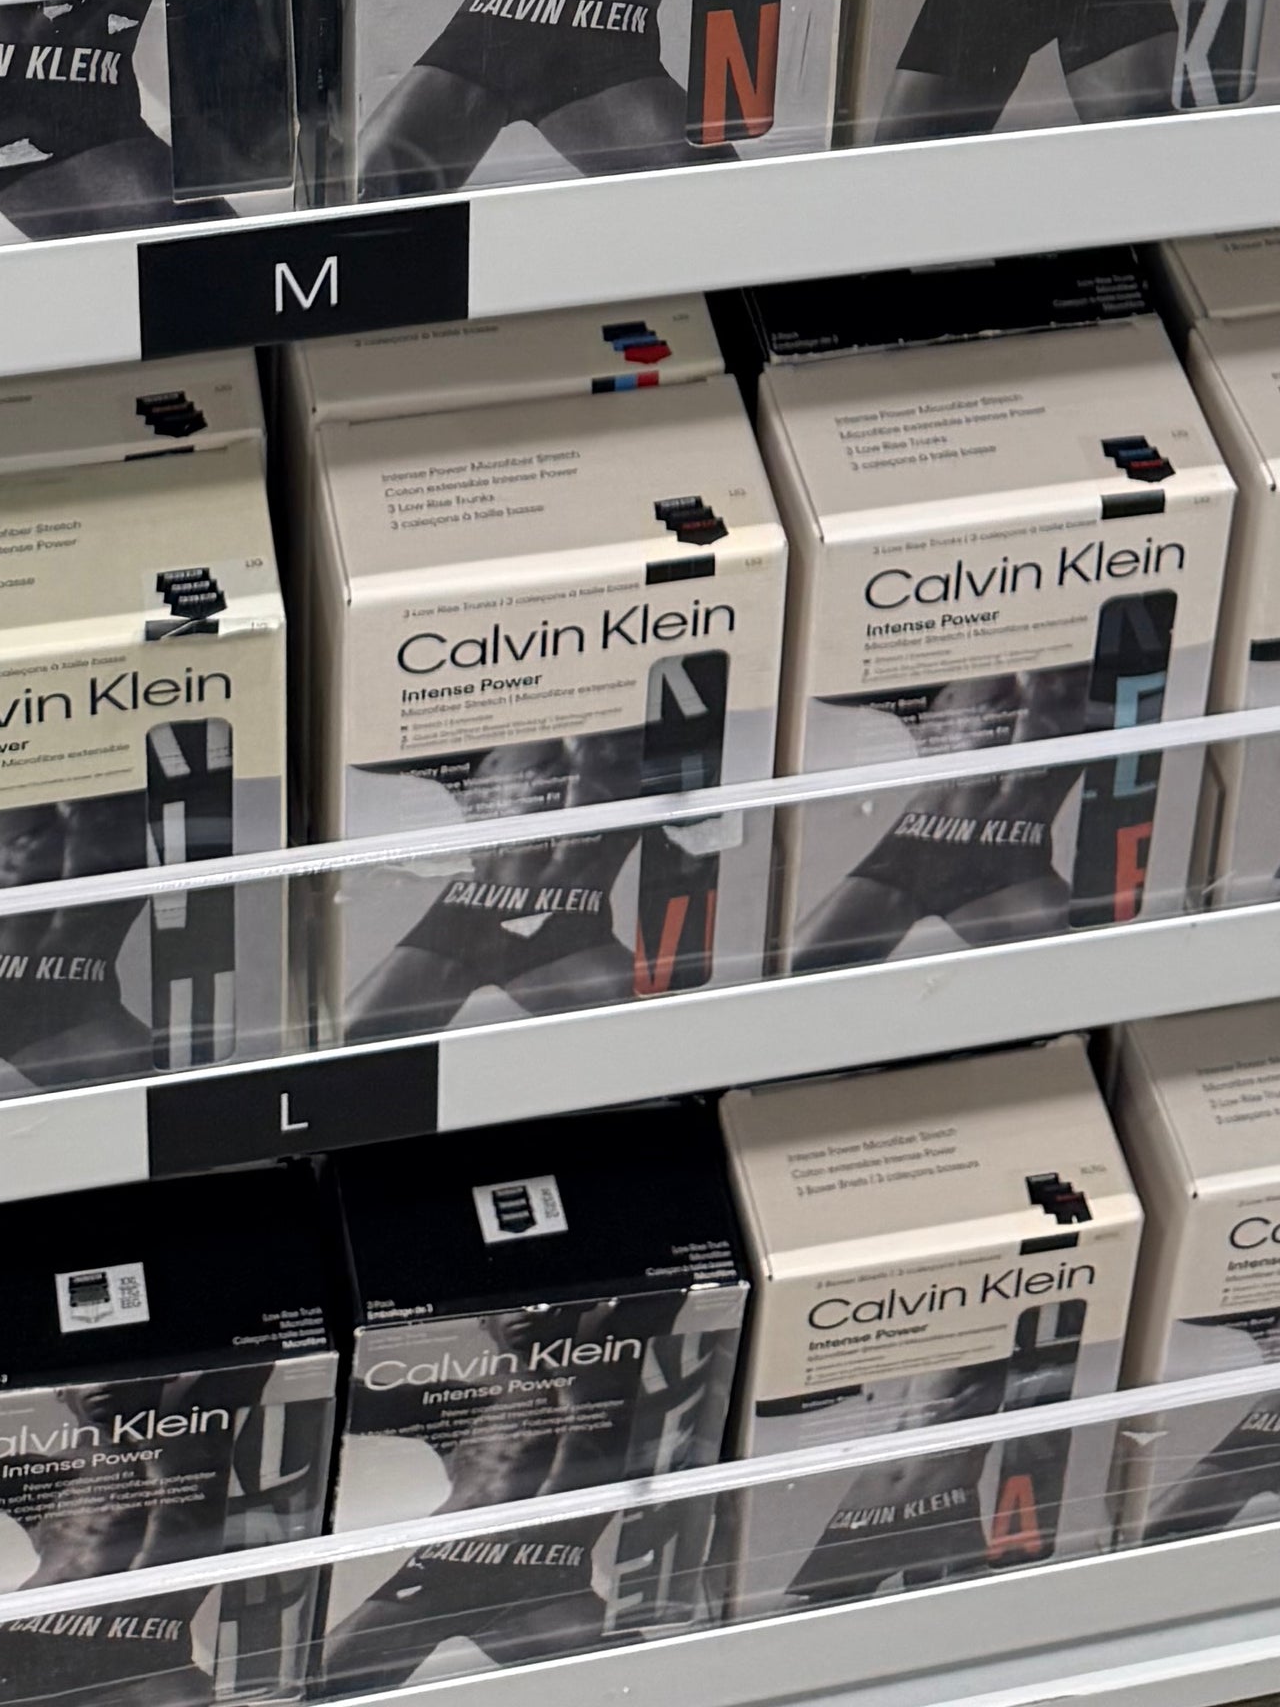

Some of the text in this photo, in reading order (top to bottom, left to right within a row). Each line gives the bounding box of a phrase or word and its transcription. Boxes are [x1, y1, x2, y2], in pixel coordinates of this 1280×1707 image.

[275, 256, 337, 312] M
[865, 537, 1185, 609] Calvin Klein
[397, 600, 735, 674] Calvin Klein
[90, 667, 231, 716] Klein
[280, 1092, 309, 1132] L
[808, 1261, 1096, 1330] Calvin Klein
[362, 1334, 642, 1392] Calvin Klein
[112, 1405, 230, 1444] Klein
